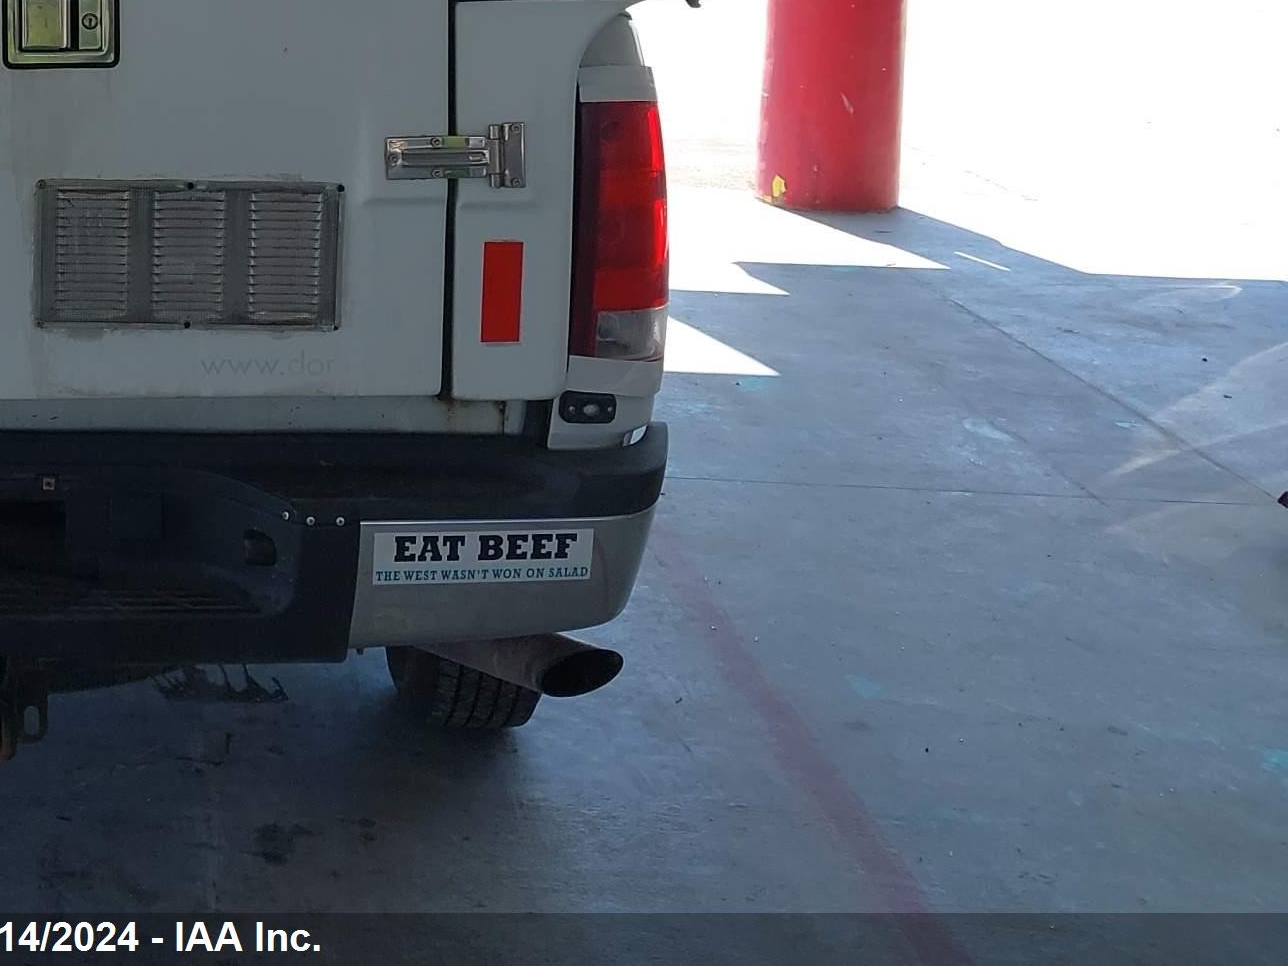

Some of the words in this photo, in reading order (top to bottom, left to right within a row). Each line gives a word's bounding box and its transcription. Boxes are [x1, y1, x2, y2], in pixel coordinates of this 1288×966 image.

[394, 535, 465, 562] EAT
[477, 533, 577, 561] BEEF
[376, 571, 401, 581] THE
[403, 571, 438, 581] WEST
[441, 569, 490, 581] WASN'T
[492, 568, 522, 579] WON
[526, 567, 545, 578] ON
[548, 566, 589, 578] SALAD
